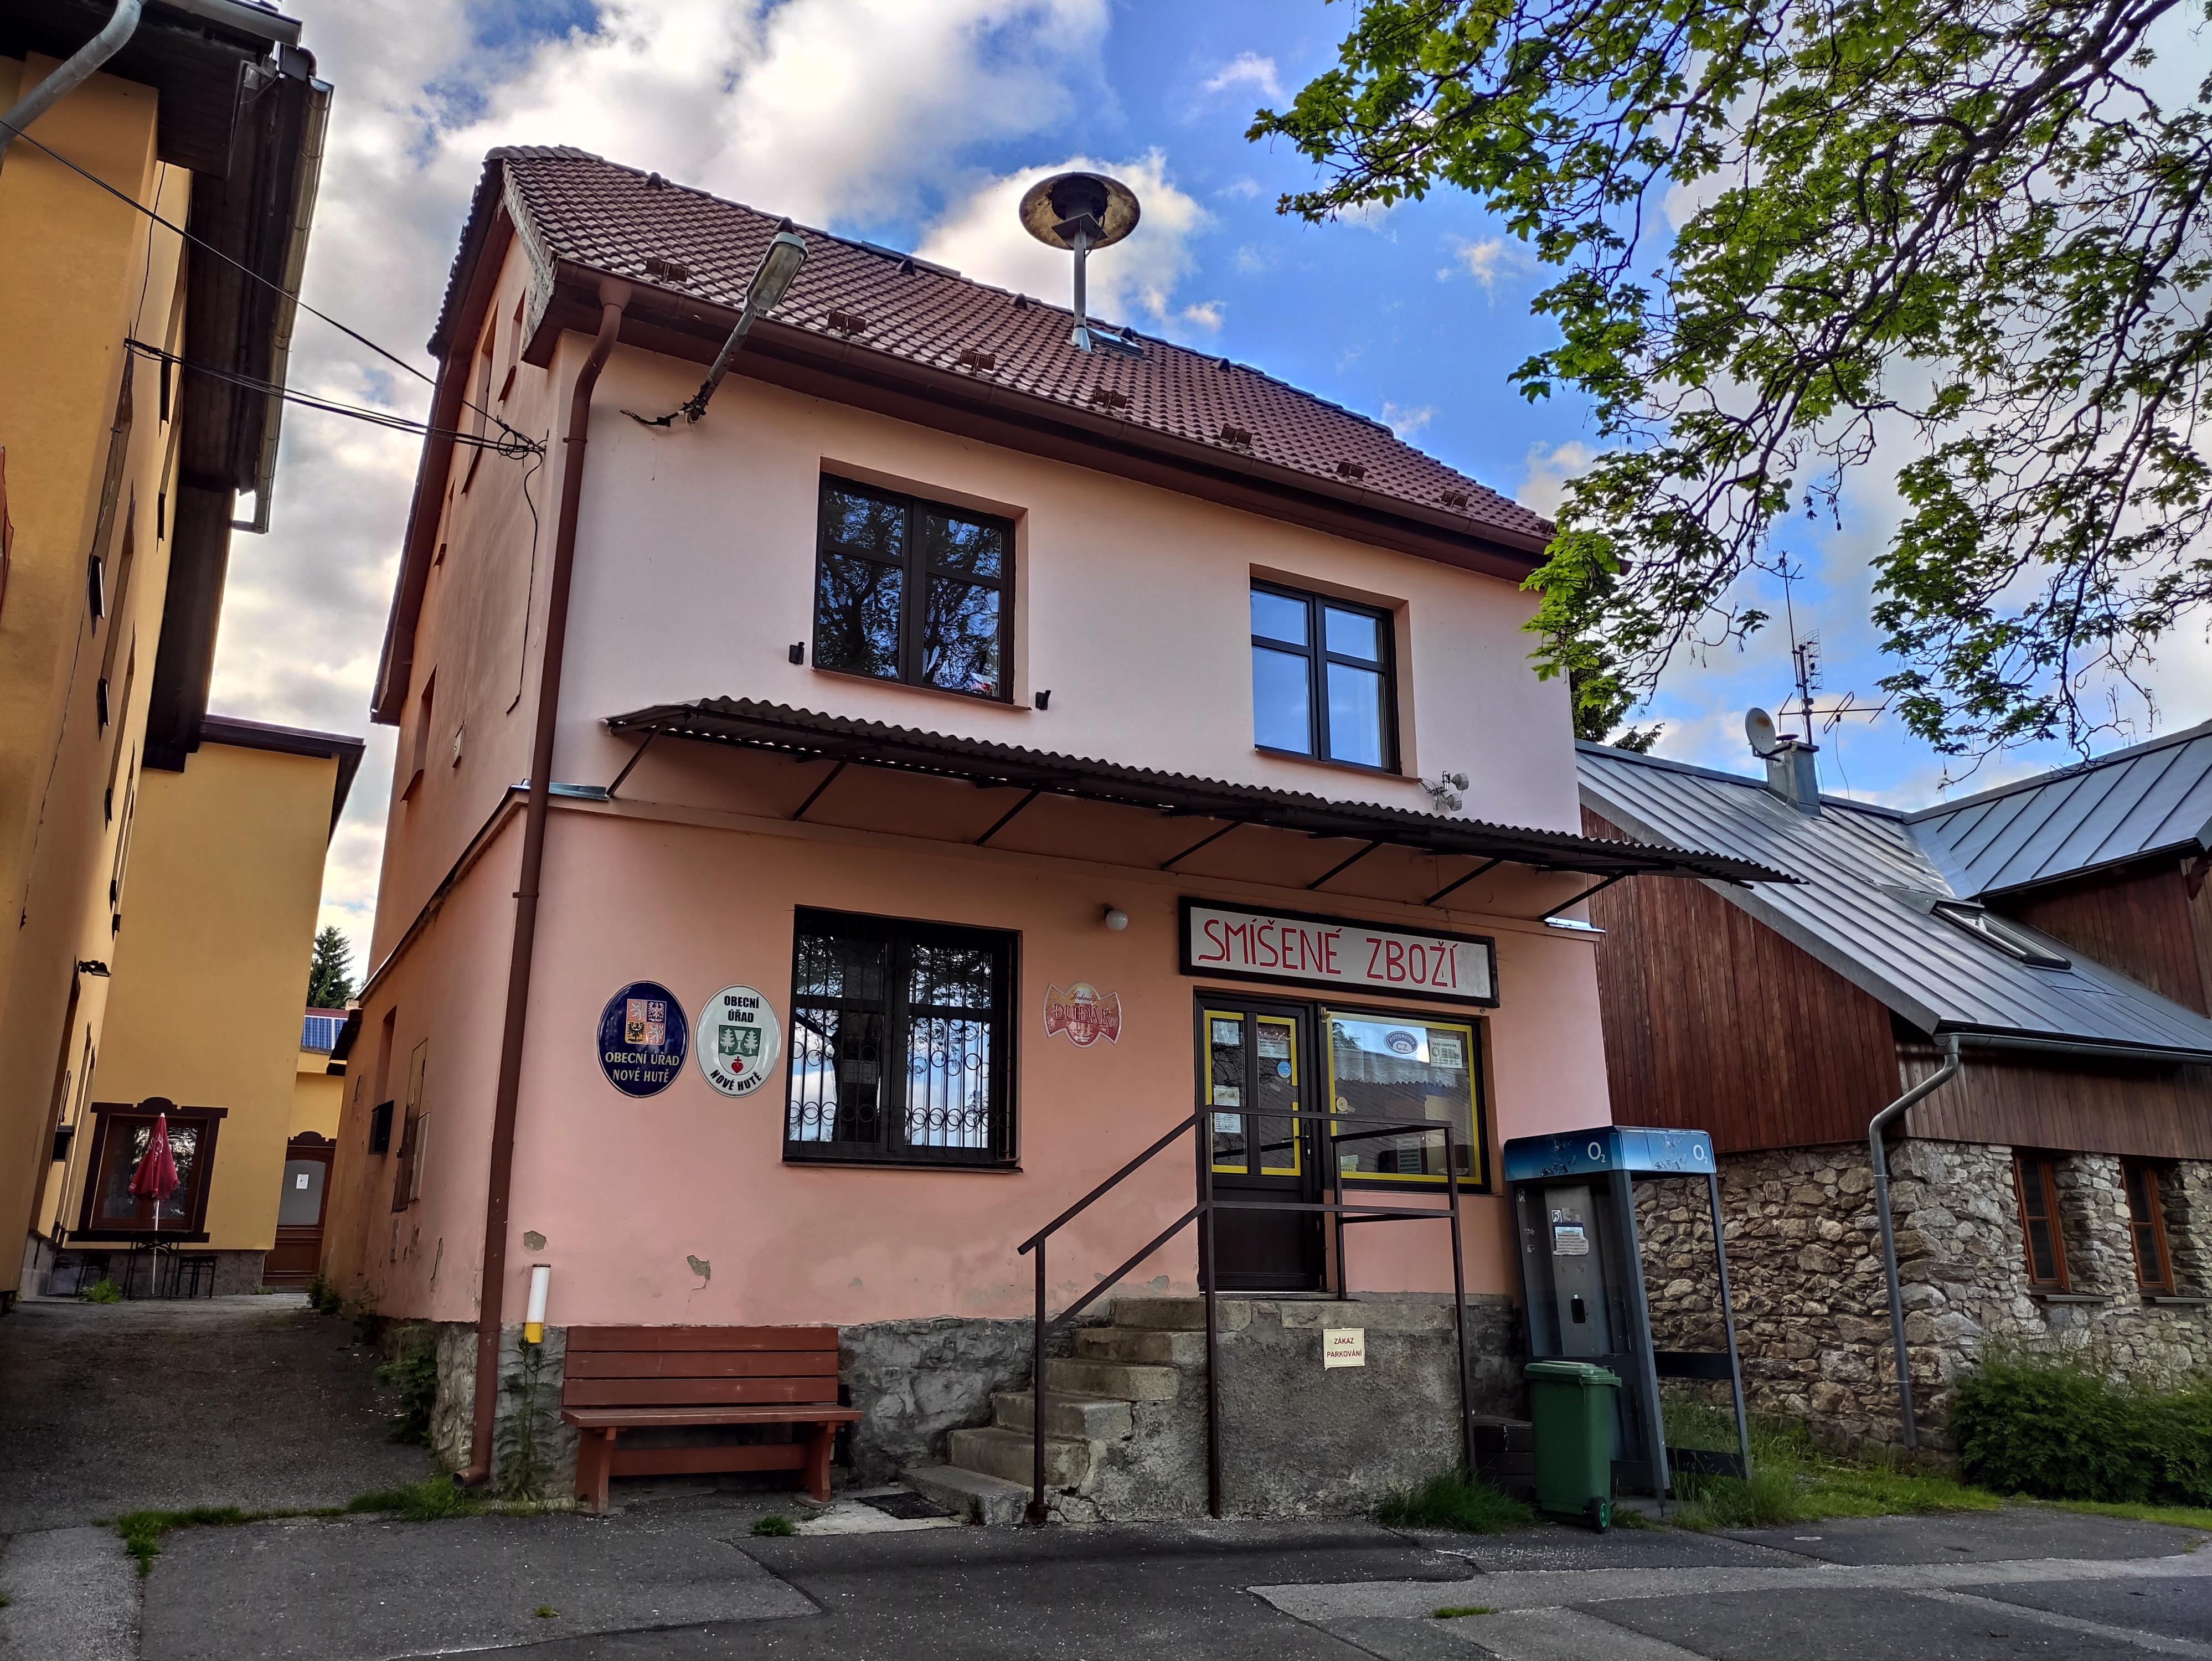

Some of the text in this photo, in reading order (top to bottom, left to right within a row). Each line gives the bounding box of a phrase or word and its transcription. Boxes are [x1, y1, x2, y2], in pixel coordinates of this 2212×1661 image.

[1198, 917, 1458, 989] SMÍŠENÉ ZBOŽÍ
[724, 995, 759, 1008] OBECNÍ
[728, 1009, 754, 1023] ÚŘAD
[1389, 1034, 1415, 1045] POTRAVINY
[1396, 1043, 1408, 1051] CZ
[605, 1051, 680, 1065] OBECNÍ ÚŘAD
[612, 1067, 669, 1082] NOVÉ HUTĚ
[710, 1069, 762, 1091] NOVÉ HUTĚ
[1327, 1349, 1362, 1358] PARKOVÁNÍ
